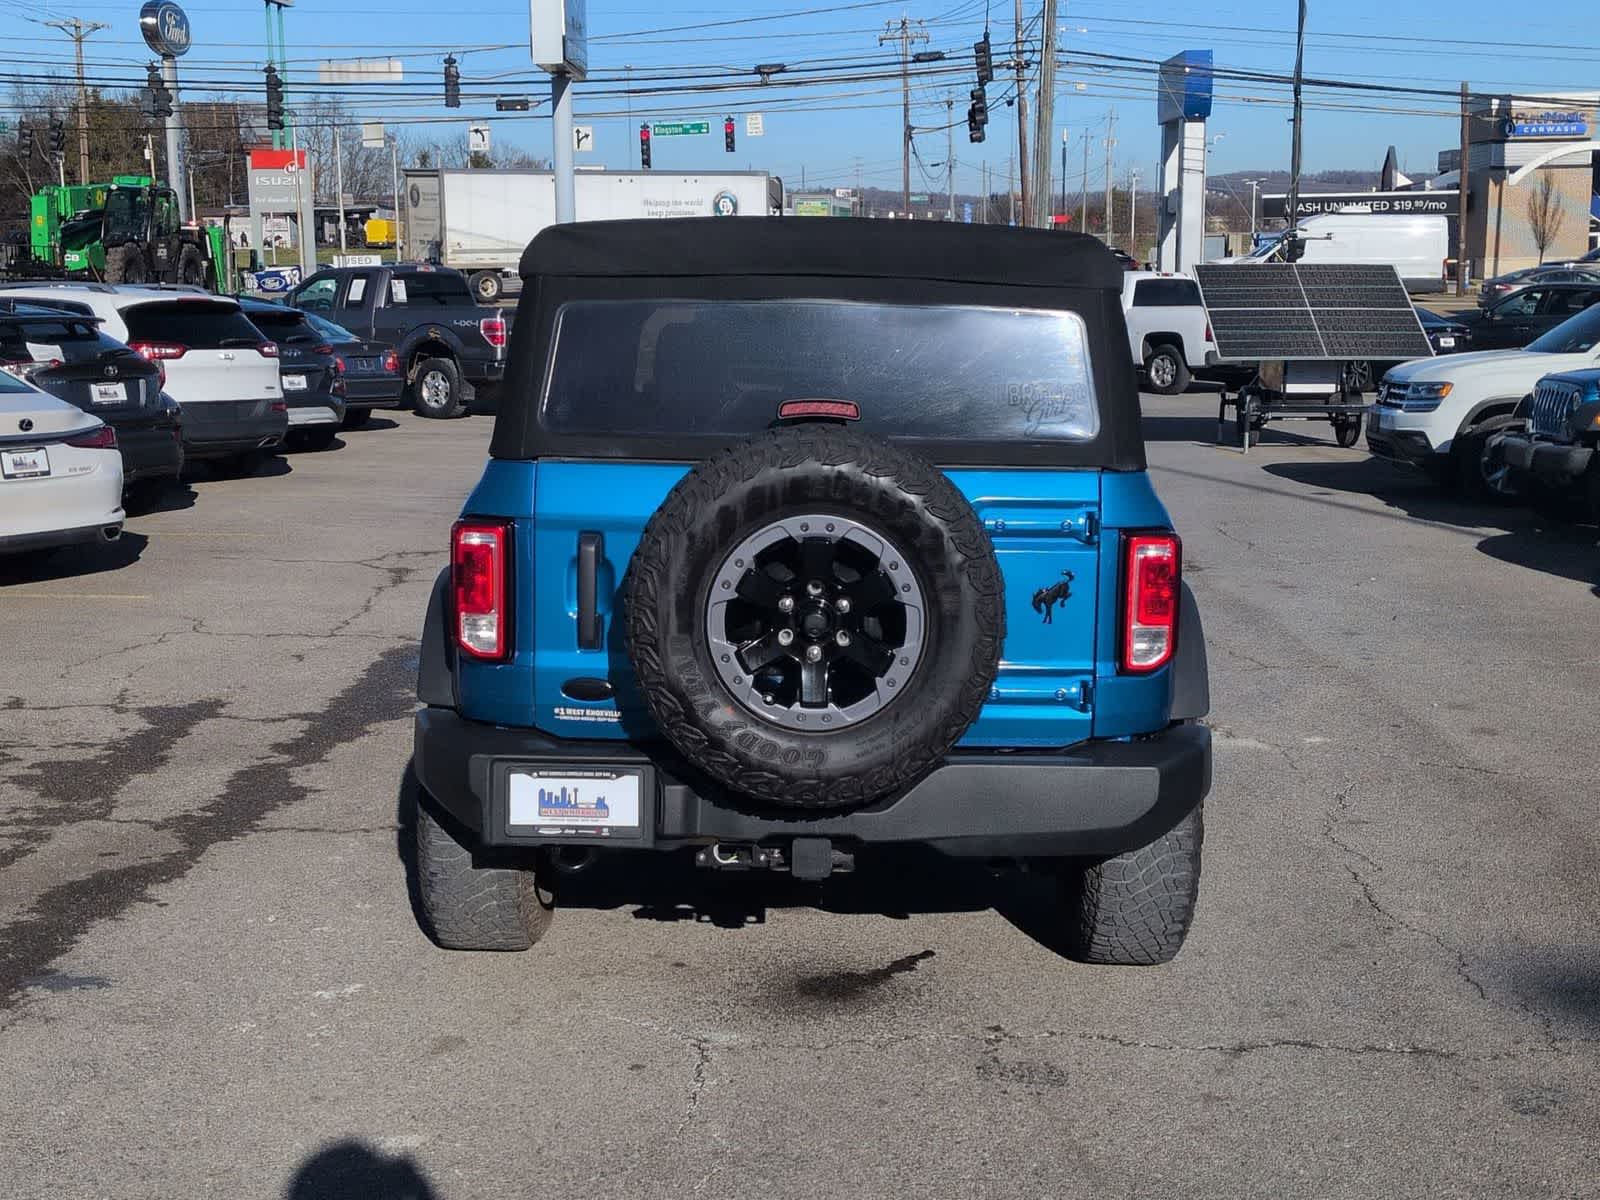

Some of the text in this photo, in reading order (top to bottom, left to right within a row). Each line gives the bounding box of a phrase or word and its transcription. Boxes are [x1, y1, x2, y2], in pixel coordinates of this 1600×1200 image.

[1523, 125, 1577, 133] CARWASH
[255, 175, 302, 186] ISUZU
[566, 707, 585, 716] WEST
